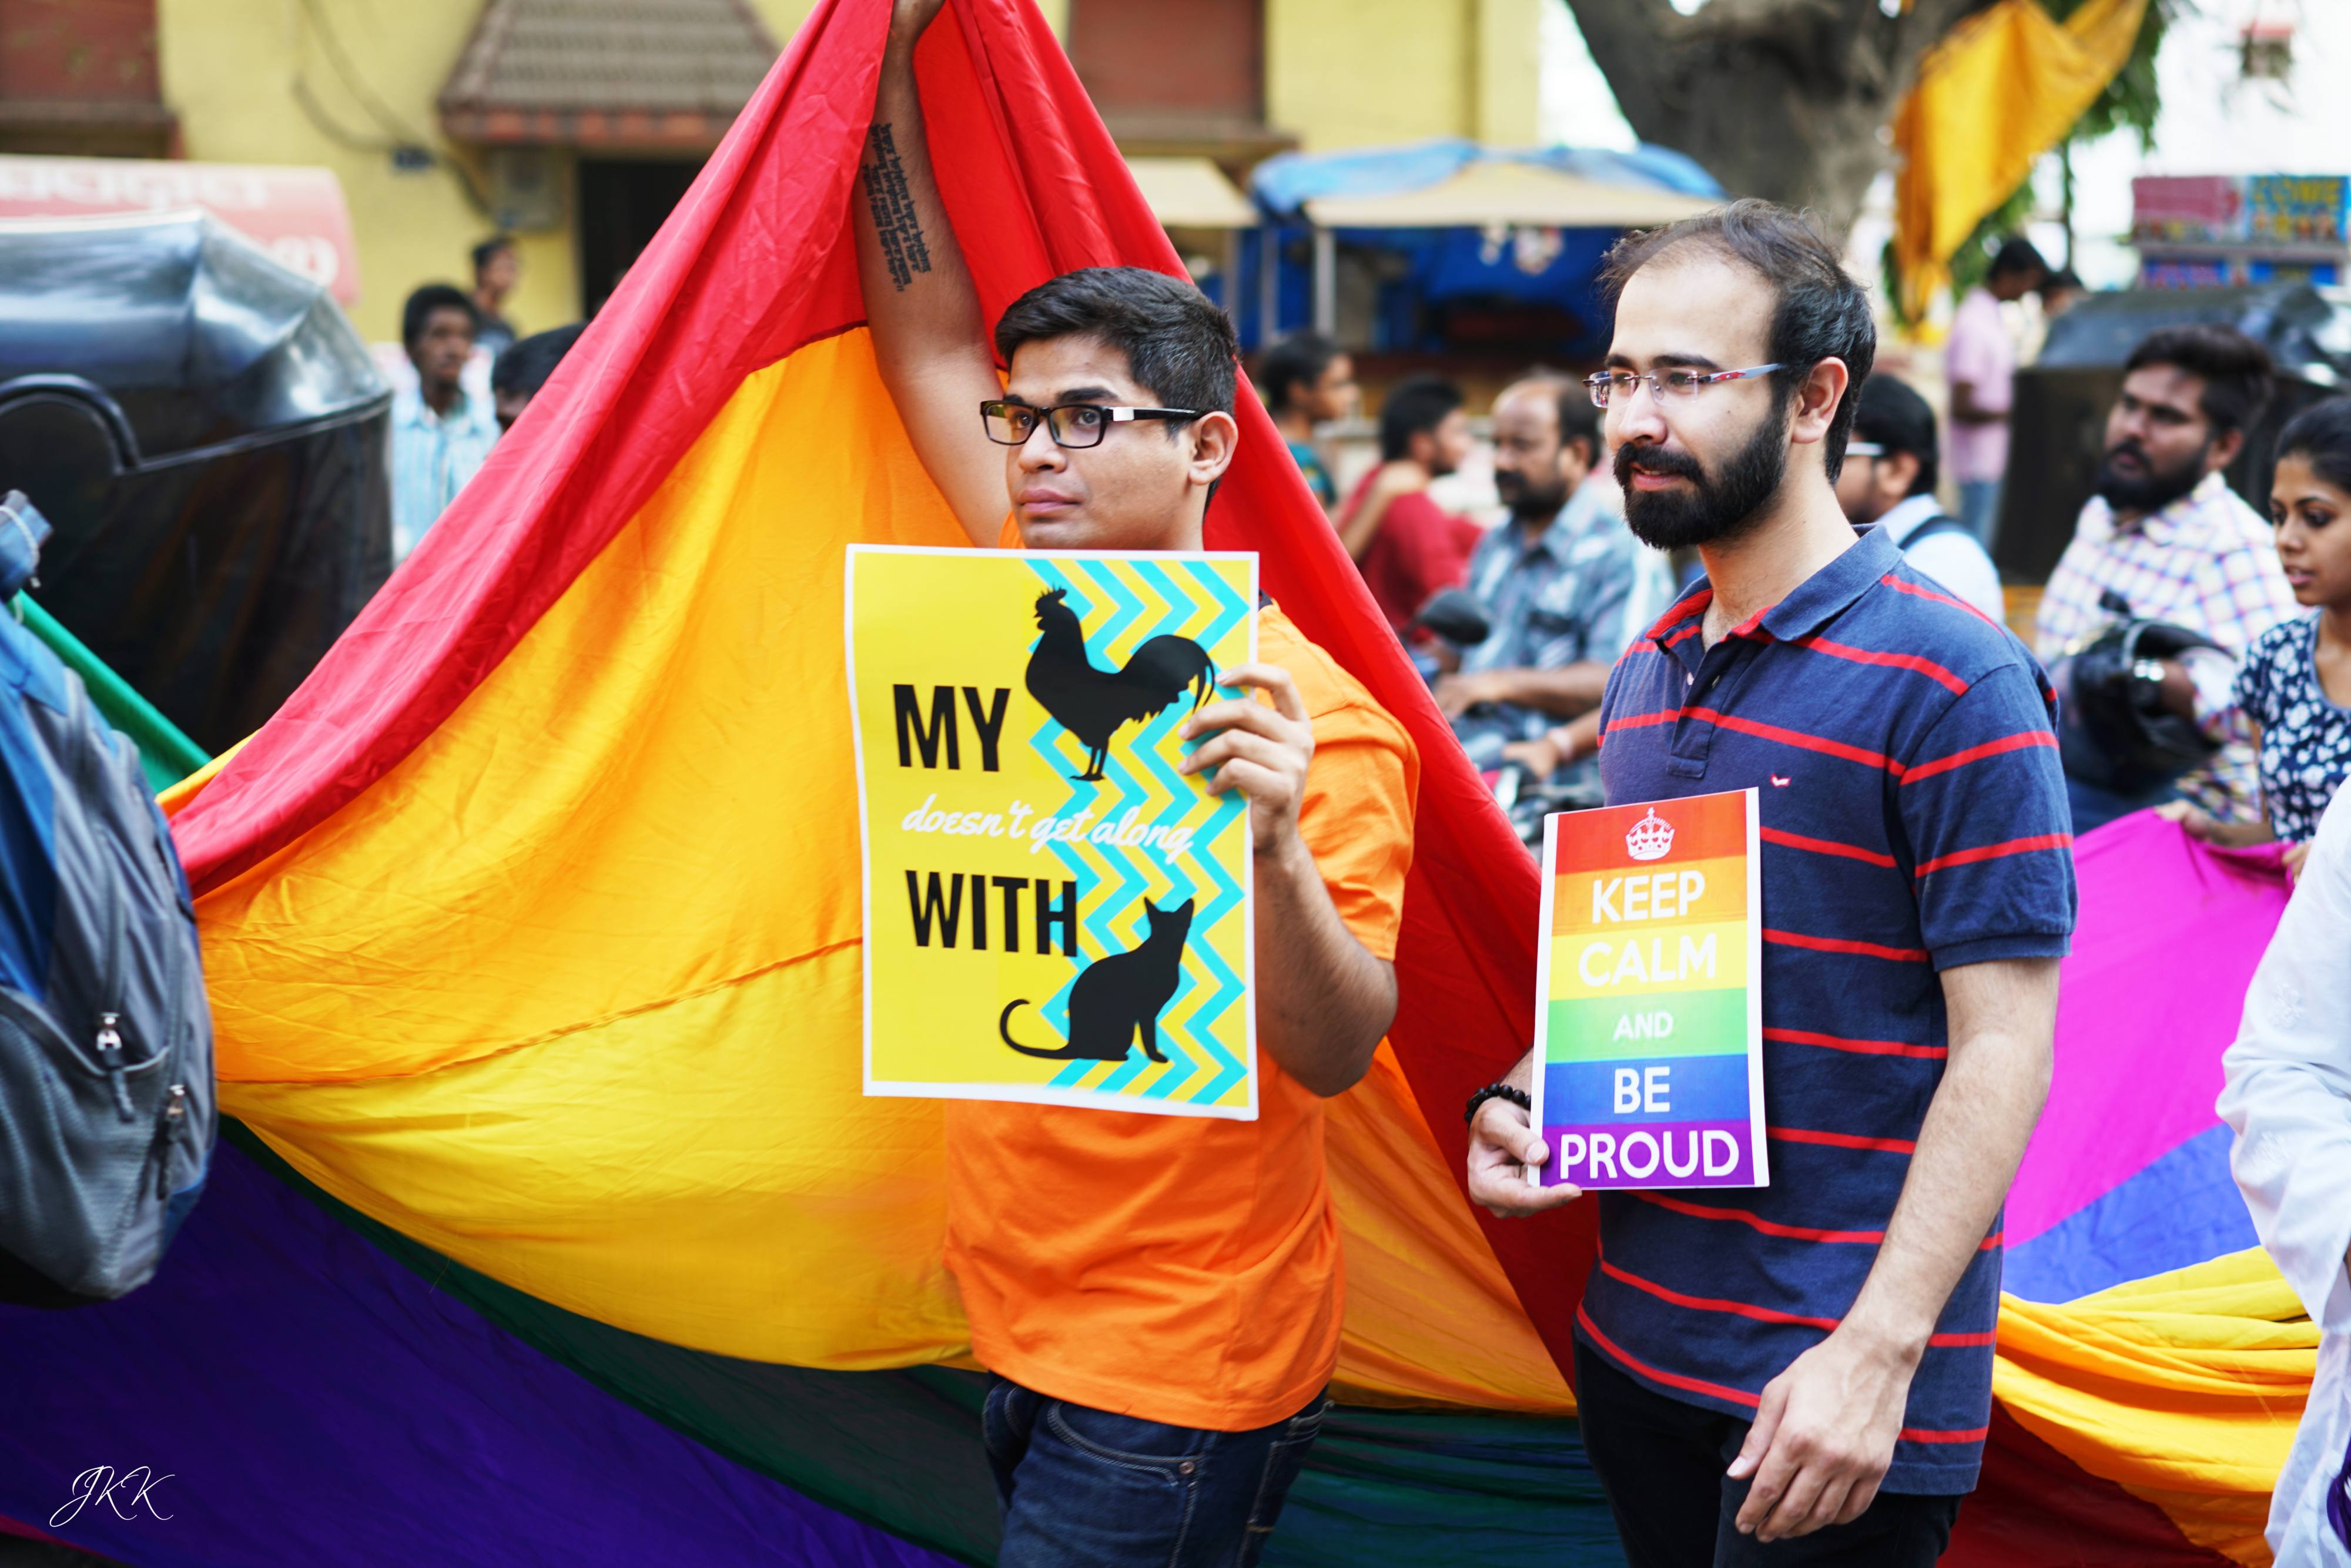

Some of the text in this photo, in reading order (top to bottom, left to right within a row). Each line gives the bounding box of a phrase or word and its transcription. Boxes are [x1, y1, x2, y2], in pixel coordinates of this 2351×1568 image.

[893, 684, 1011, 772] MY
[901, 793, 1195, 865] doesn't get along
[905, 870, 1077, 957] WITH
[1592, 870, 1705, 924] KEEP
[1578, 933, 1717, 987] CALM
[1612, 1011, 1674, 1041] AND
[1613, 1066, 1671, 1114] BE
[1560, 1130, 1740, 1179] PROUD
